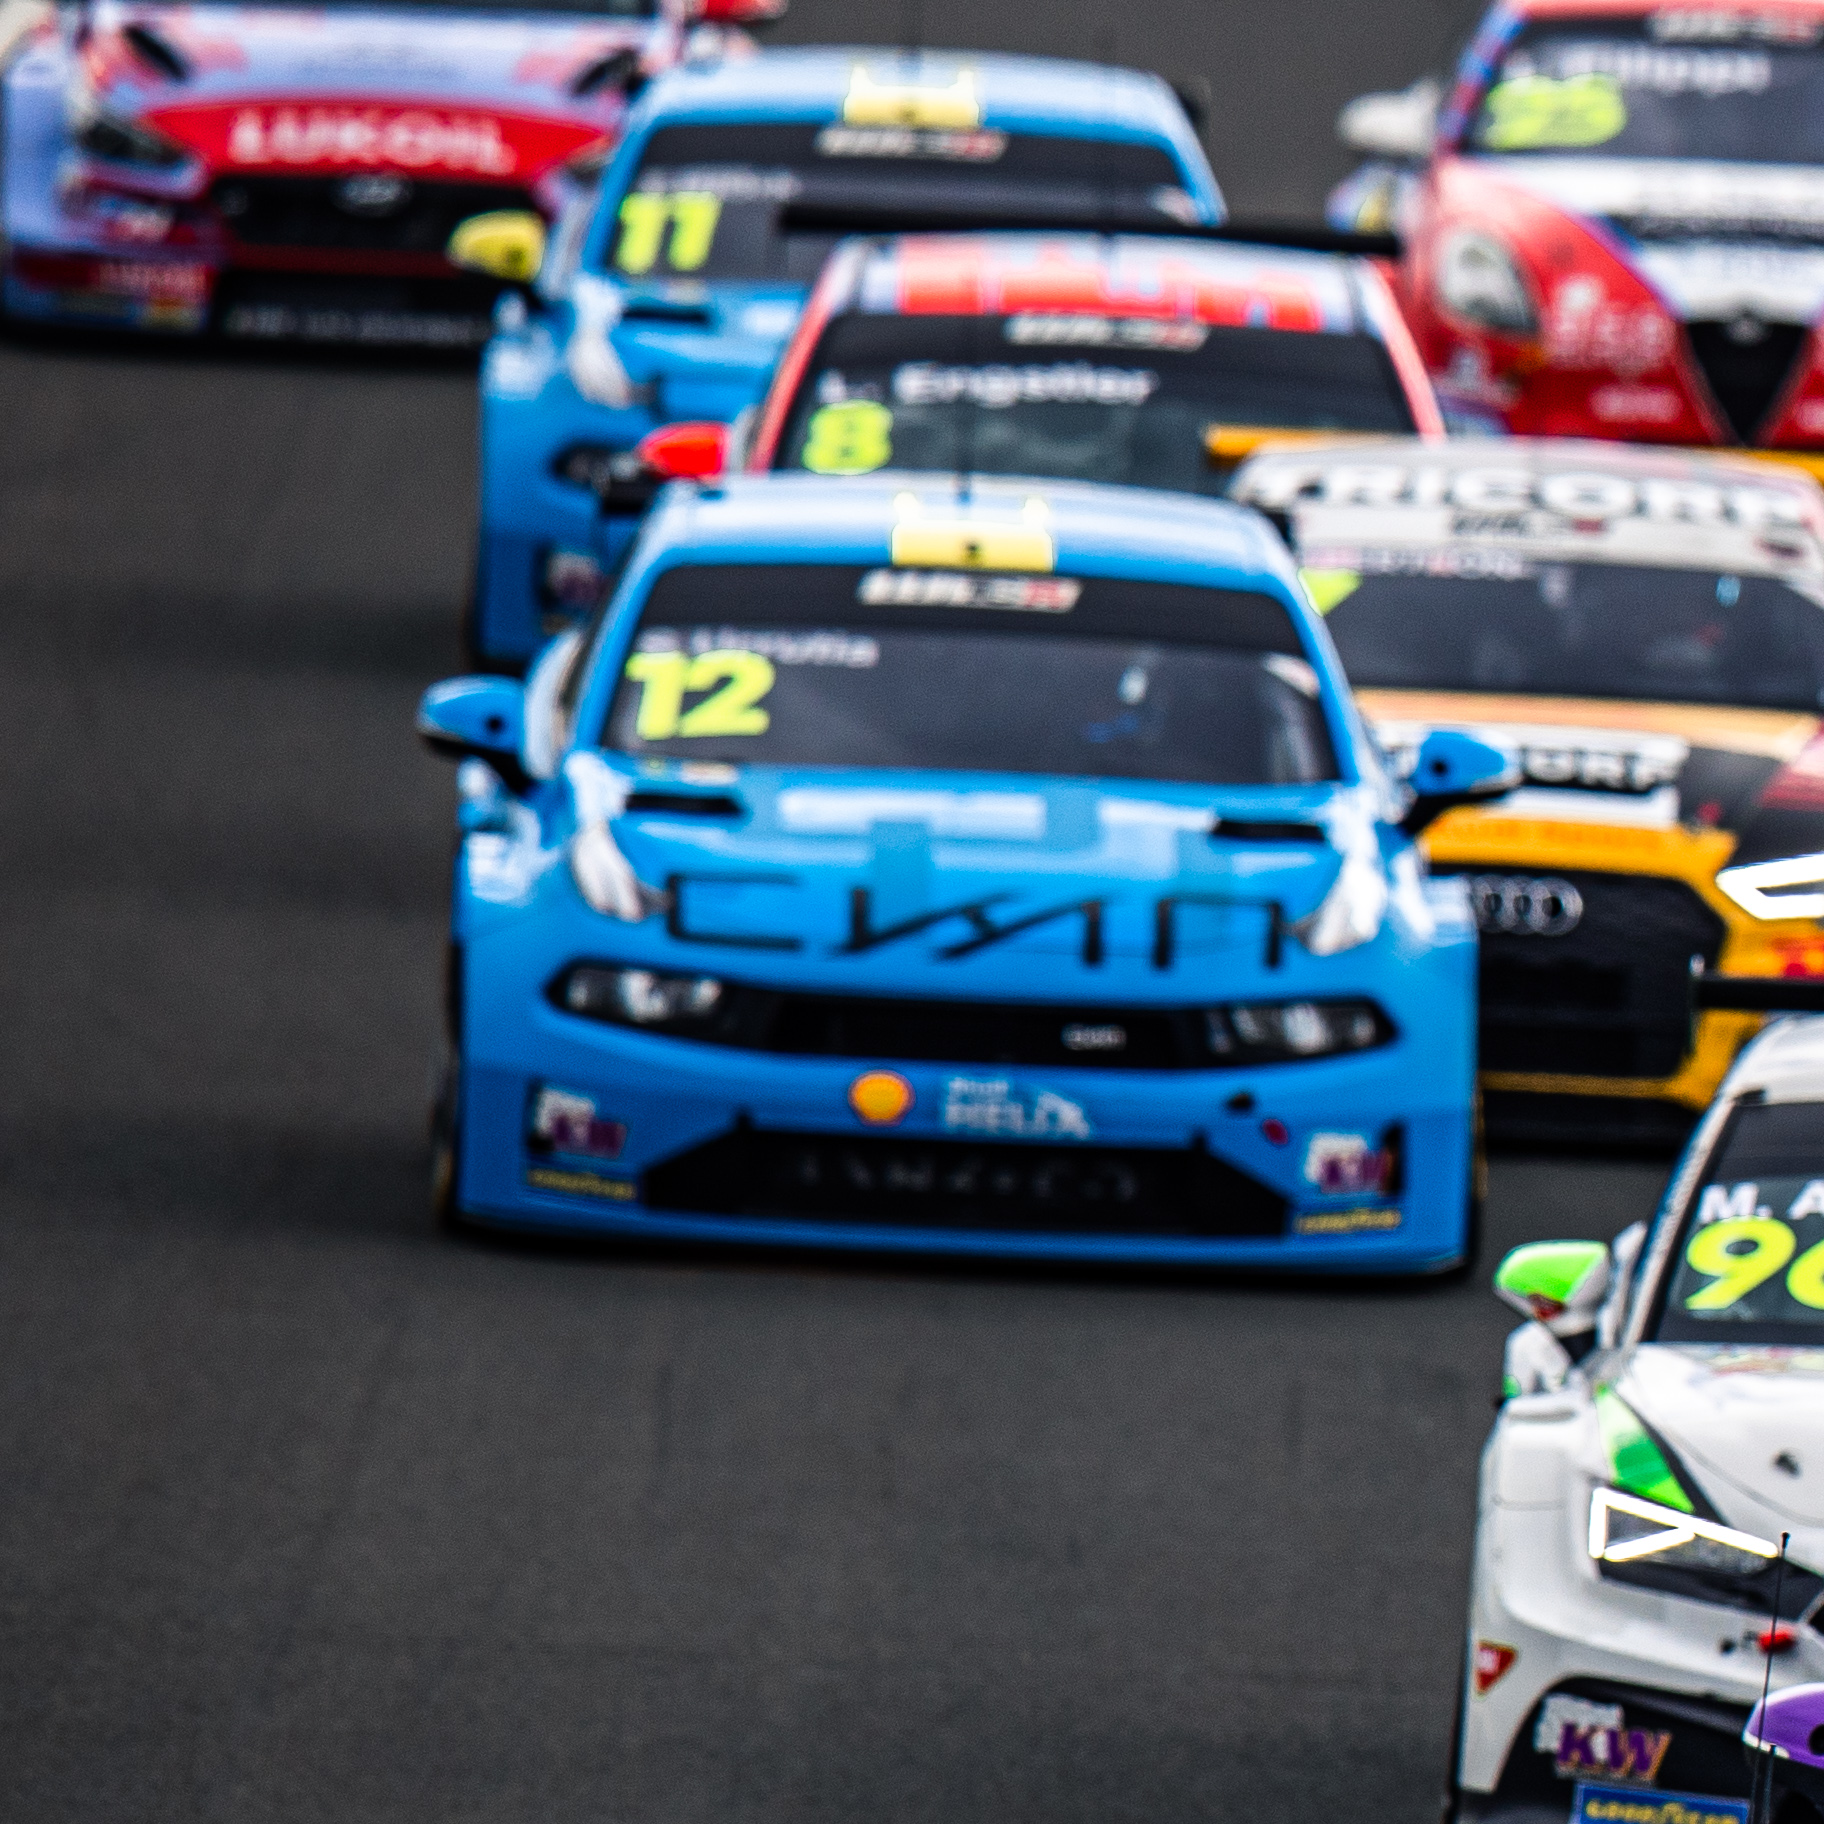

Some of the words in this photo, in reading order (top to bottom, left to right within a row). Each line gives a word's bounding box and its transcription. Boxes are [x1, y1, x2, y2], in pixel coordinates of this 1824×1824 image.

[616, 190, 723, 275] 11
[802, 399, 893, 476] 8
[625, 647, 777, 741] 12
[1698, 1183, 1773, 1223] M.
